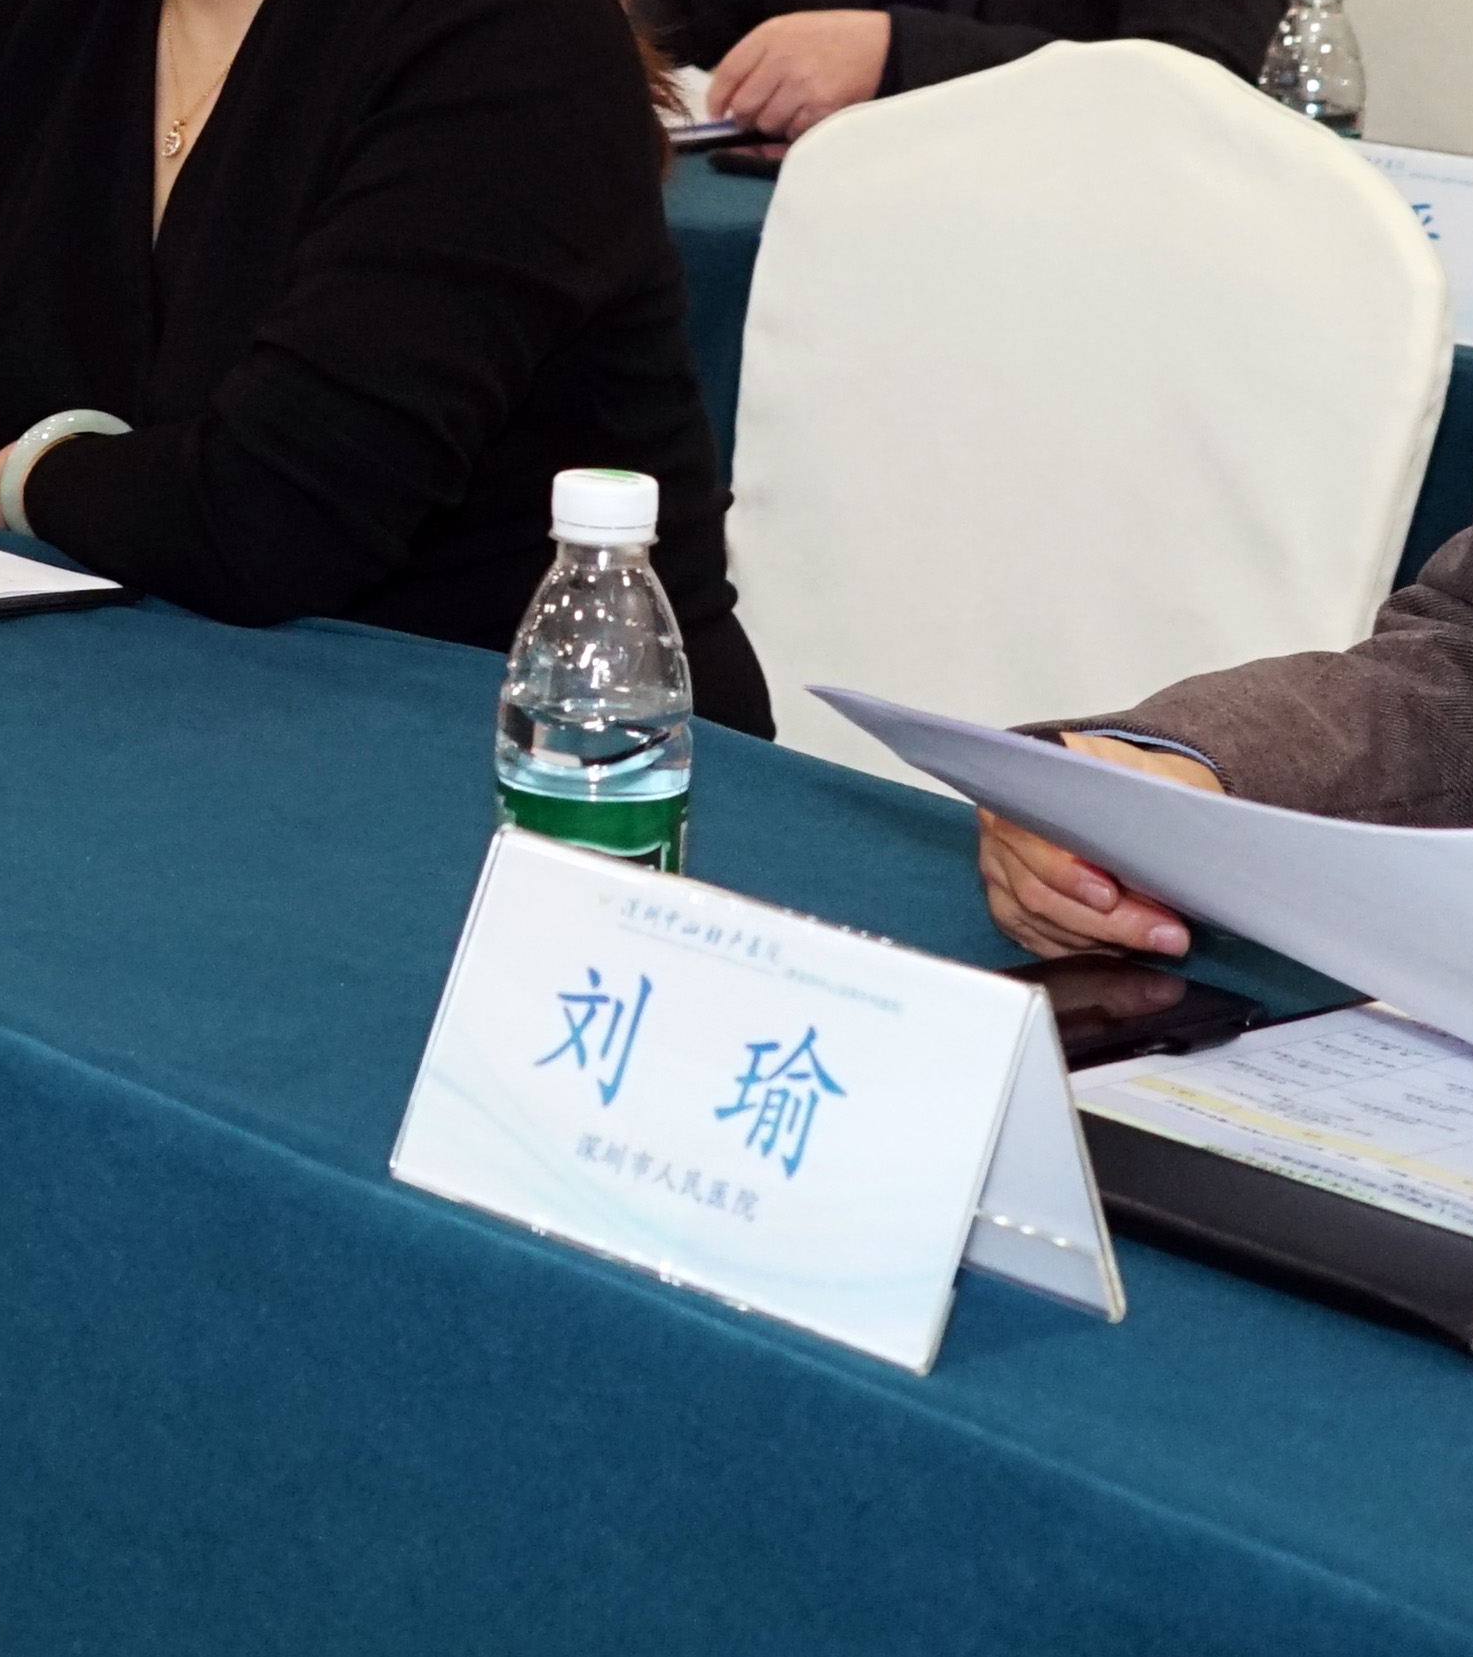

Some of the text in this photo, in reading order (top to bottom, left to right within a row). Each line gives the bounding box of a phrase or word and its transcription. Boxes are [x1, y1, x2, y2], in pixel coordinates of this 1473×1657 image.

[532, 966, 849, 1180] 刘瑜
[575, 1131, 760, 1222] 深圳市人民医院
